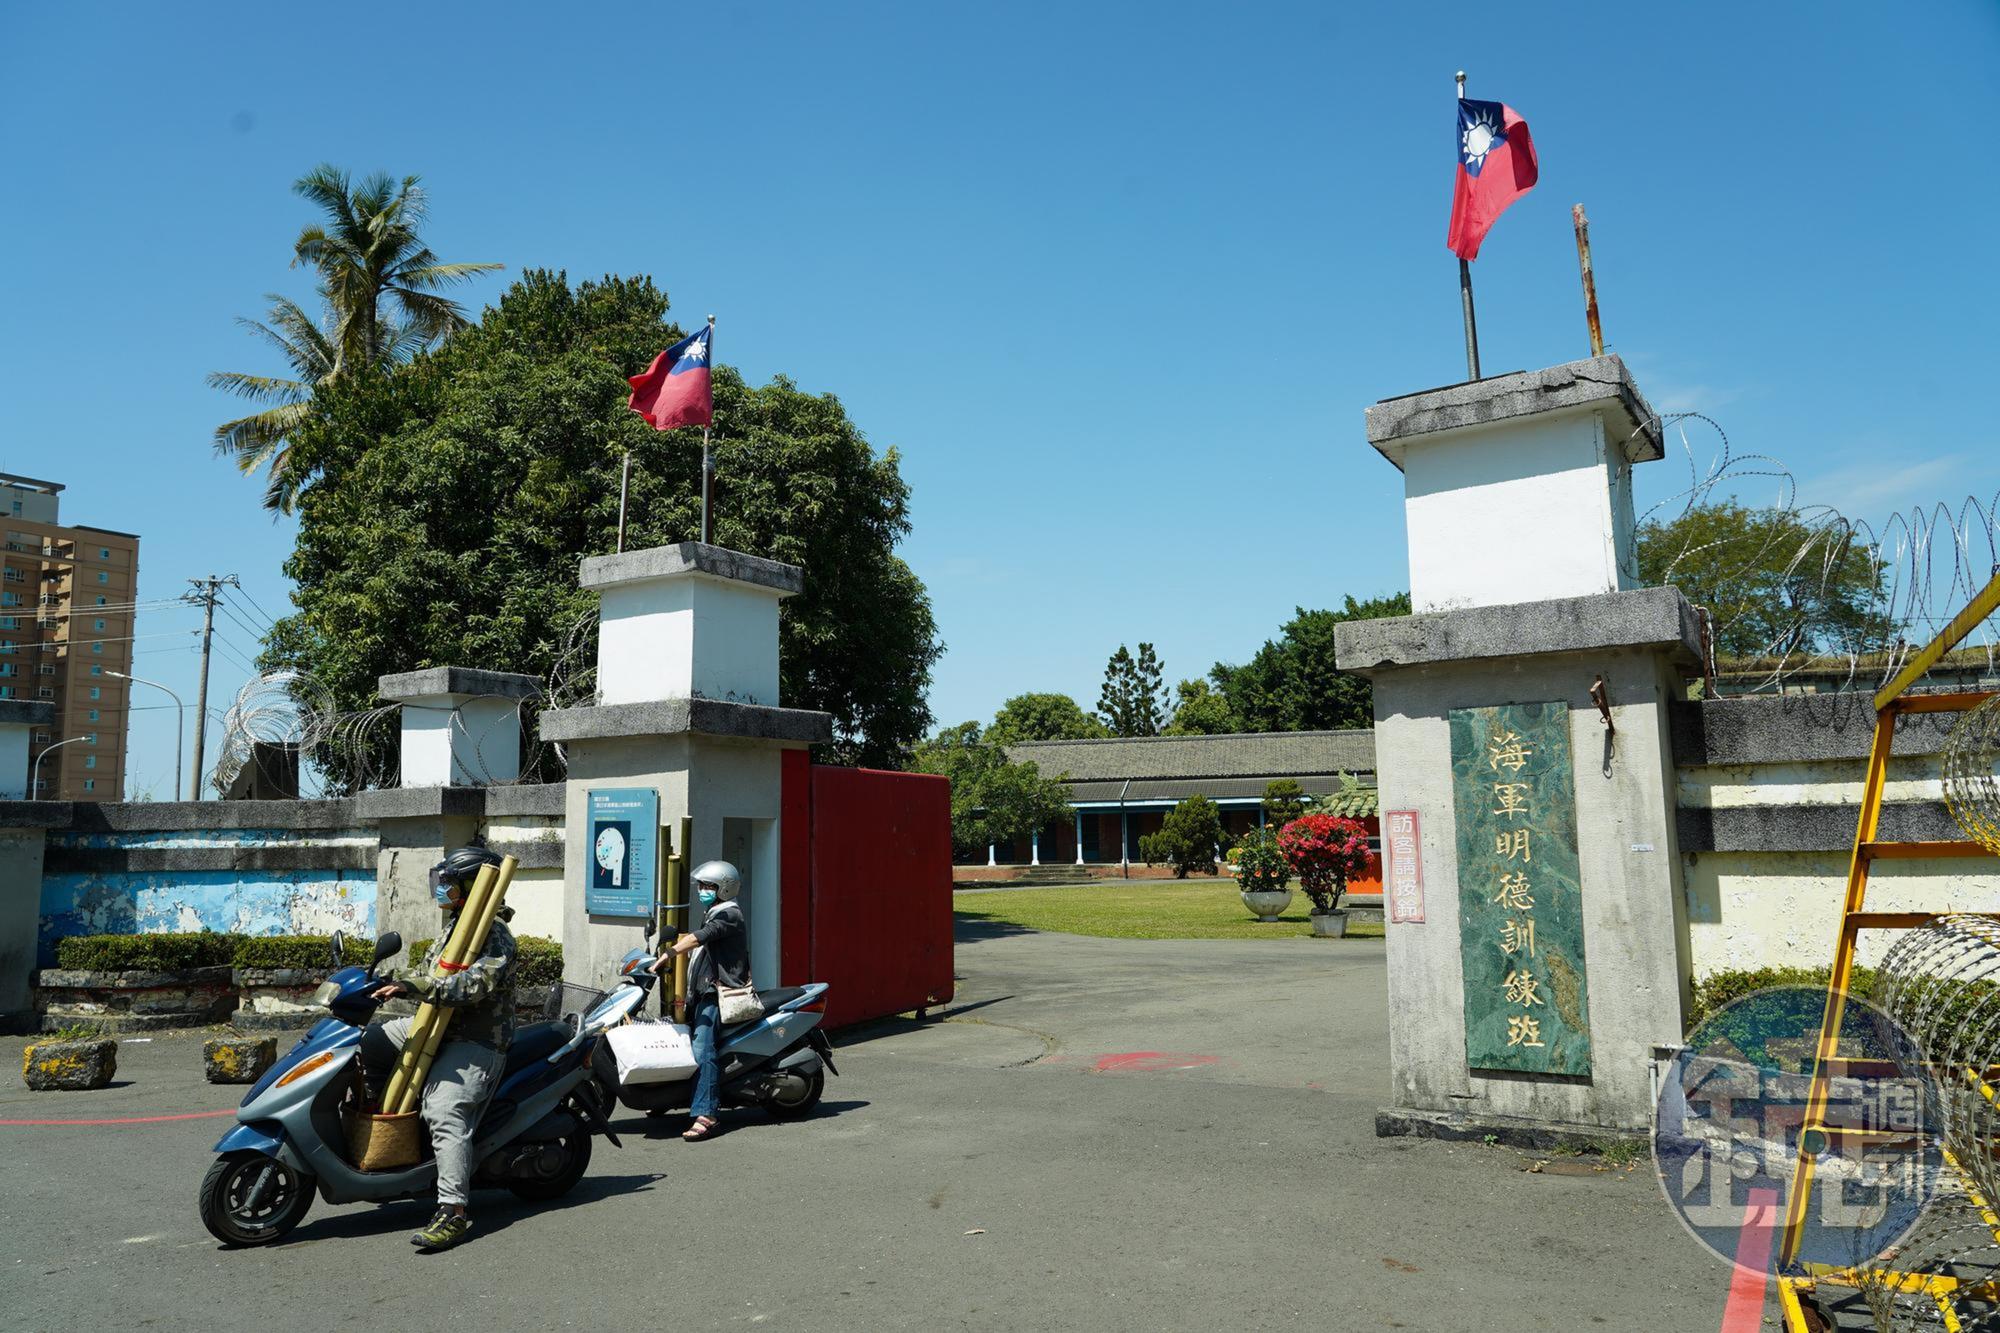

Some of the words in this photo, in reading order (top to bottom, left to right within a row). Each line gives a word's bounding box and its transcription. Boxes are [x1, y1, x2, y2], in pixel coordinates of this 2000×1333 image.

[1392, 815, 1417, 917] 訪客請按鈴
[1489, 731, 1545, 1047] 海軍明德訓練班
